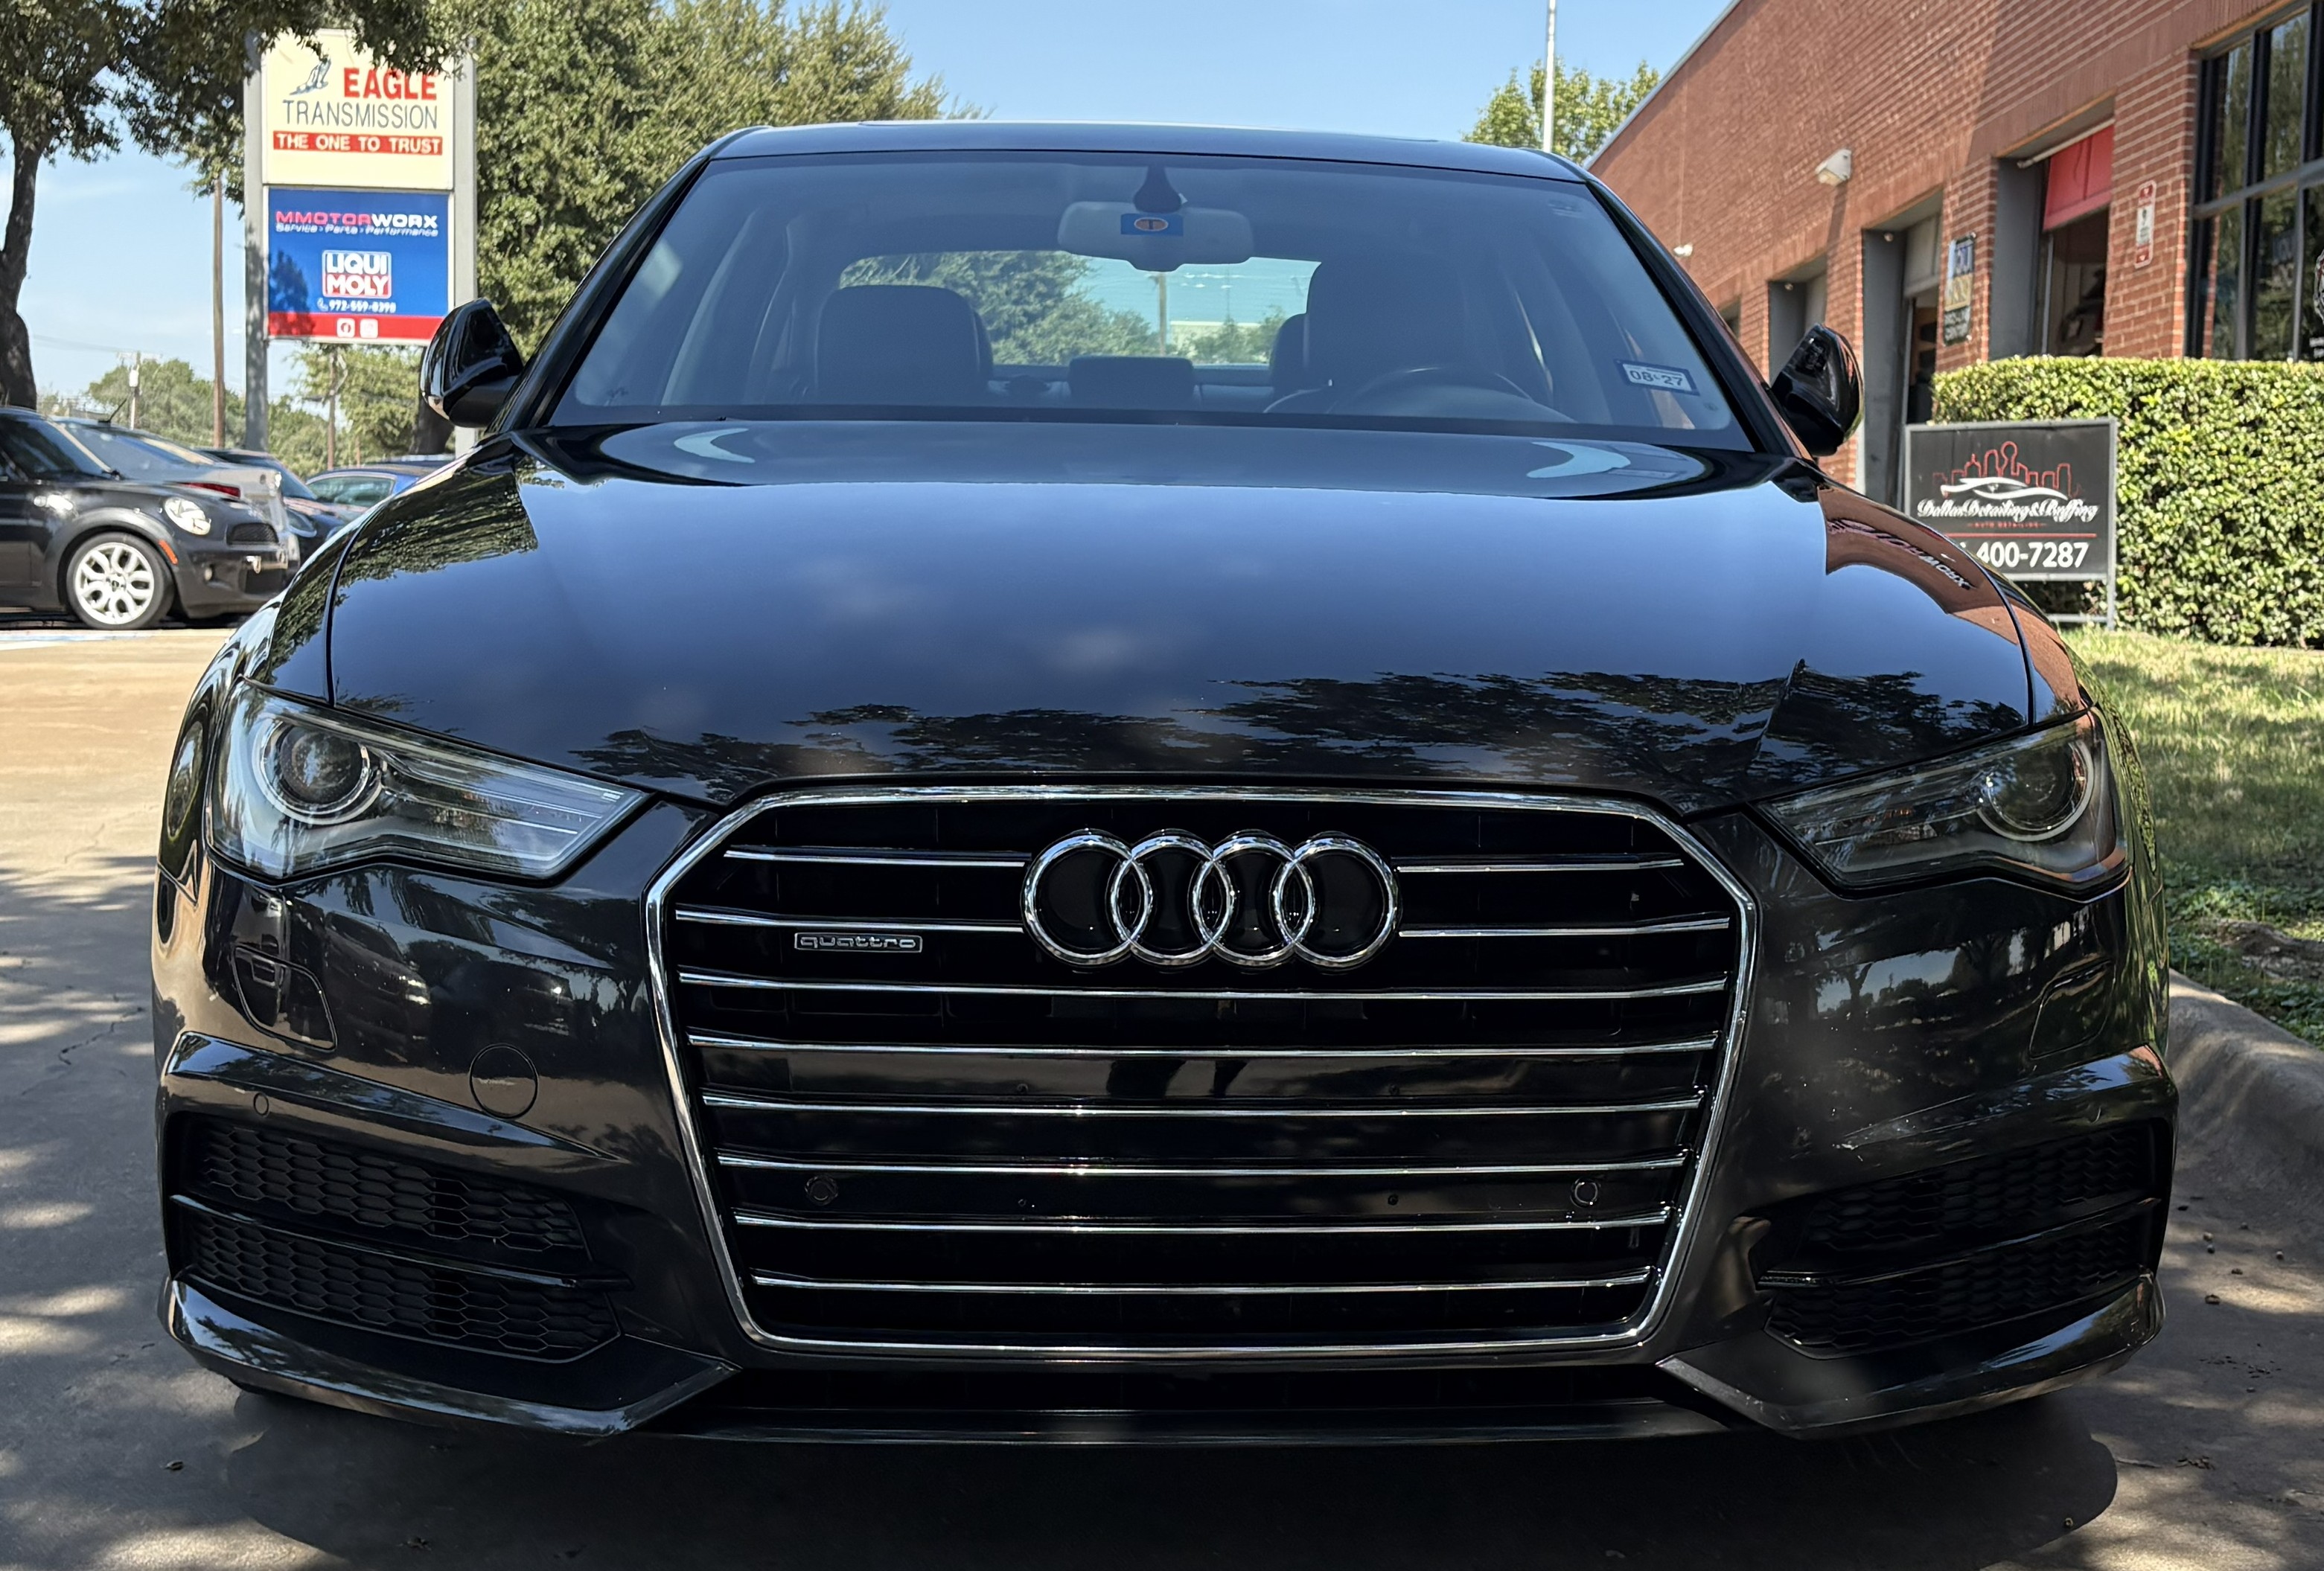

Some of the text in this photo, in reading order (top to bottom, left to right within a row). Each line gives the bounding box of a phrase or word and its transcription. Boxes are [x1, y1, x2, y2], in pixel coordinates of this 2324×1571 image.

[343, 67, 438, 100] EAGLE
[282, 100, 438, 129] TRANSMISSION
[276, 133, 441, 154] THE ONE TO TRUST
[275, 223, 318, 233] Service
[365, 225, 439, 237] Performance
[327, 252, 388, 275] LIQUI
[327, 274, 389, 297] MOLY
[1976, 541, 2089, 568] 400-7287
[800, 935, 916, 948] quattro
